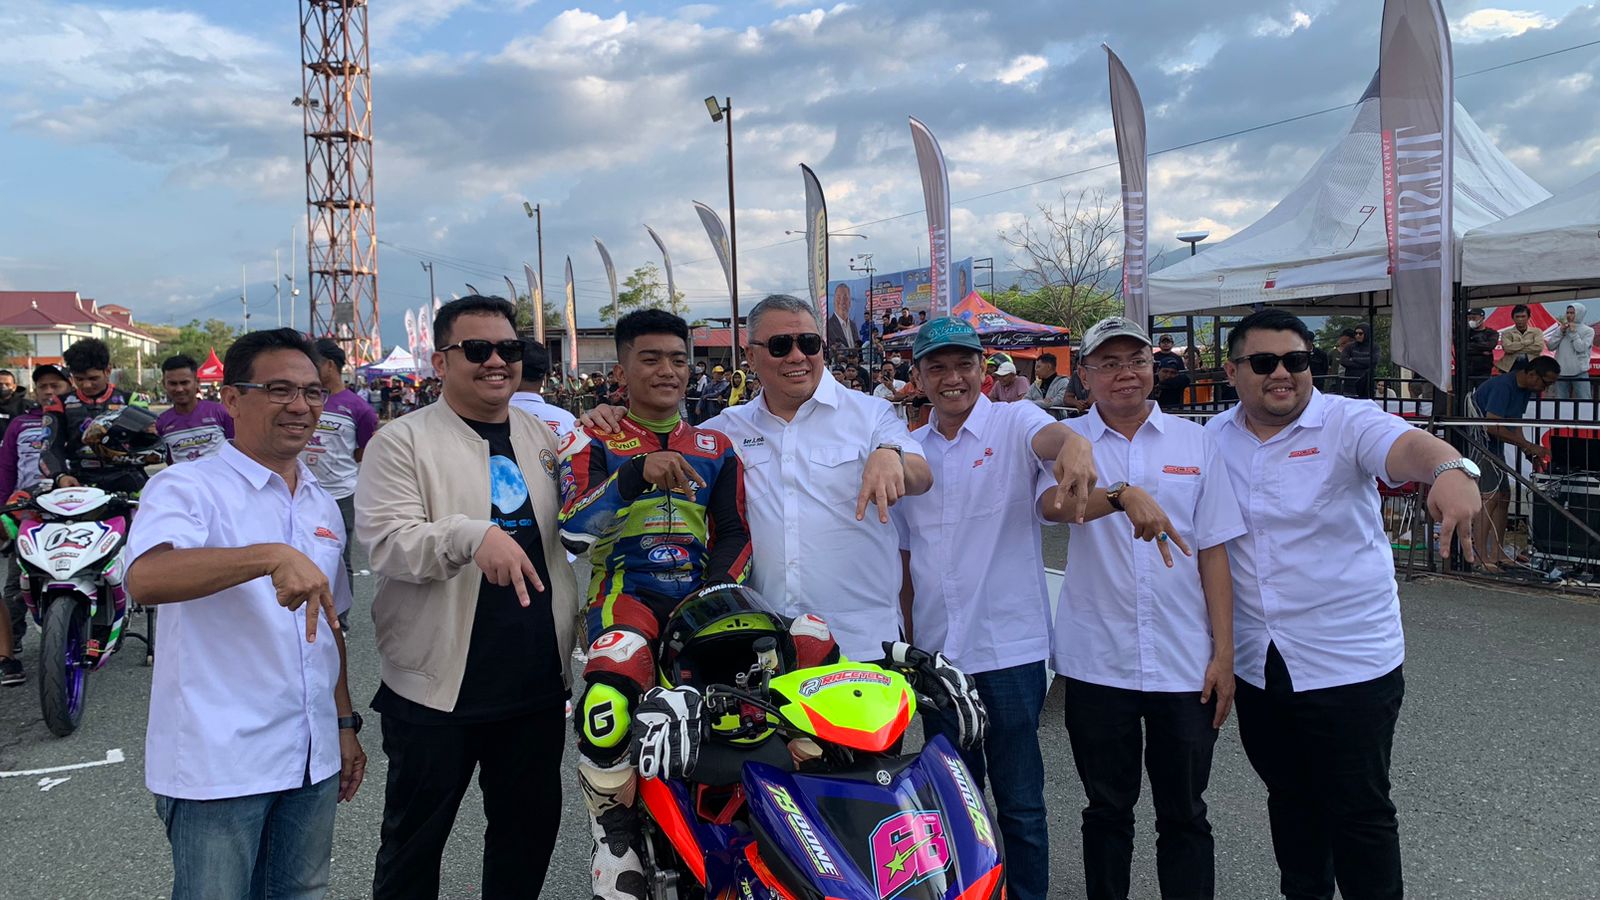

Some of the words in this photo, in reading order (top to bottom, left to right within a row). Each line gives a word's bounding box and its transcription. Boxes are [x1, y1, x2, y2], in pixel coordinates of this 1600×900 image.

[696, 432, 716, 451] G
[820, 670, 892, 686] RACETECH
[588, 700, 616, 739] G
